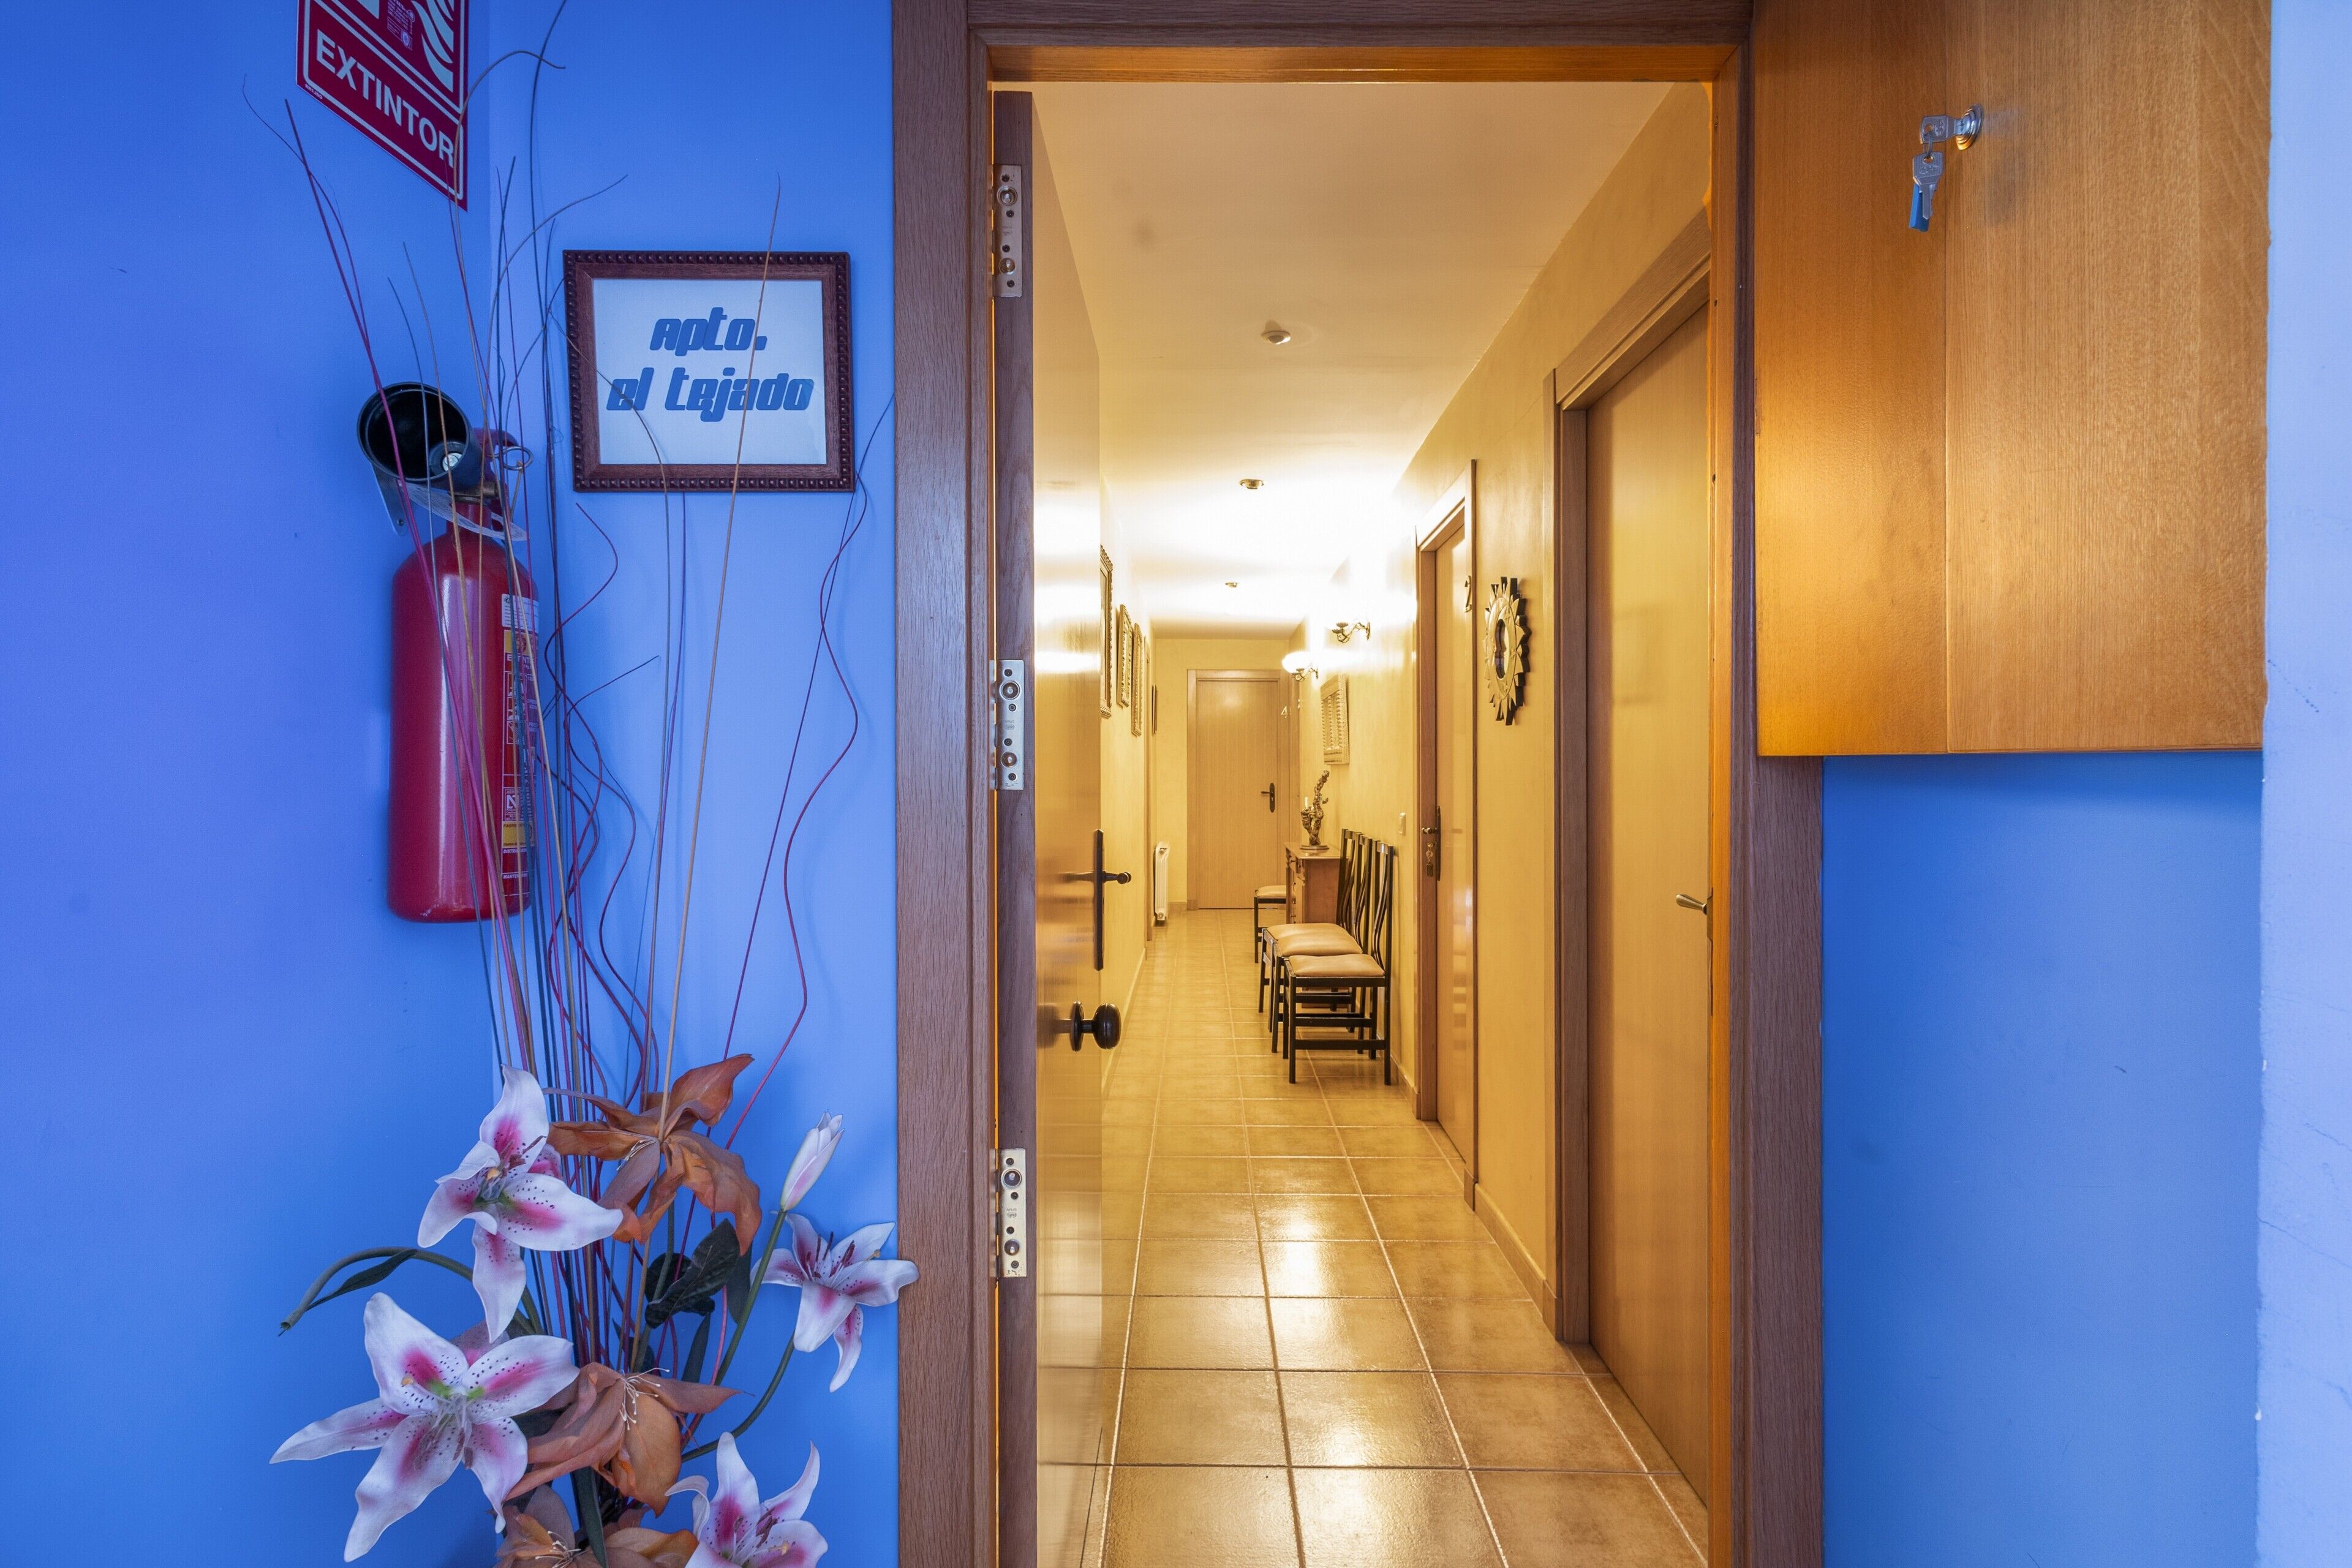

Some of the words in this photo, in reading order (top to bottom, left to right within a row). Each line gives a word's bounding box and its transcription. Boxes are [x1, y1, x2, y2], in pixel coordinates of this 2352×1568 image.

[316, 29, 454, 168] EXTINTOR
[606, 368, 655, 411] el
[665, 368, 815, 422] tejado
[1280, 706, 1289, 719] 4
